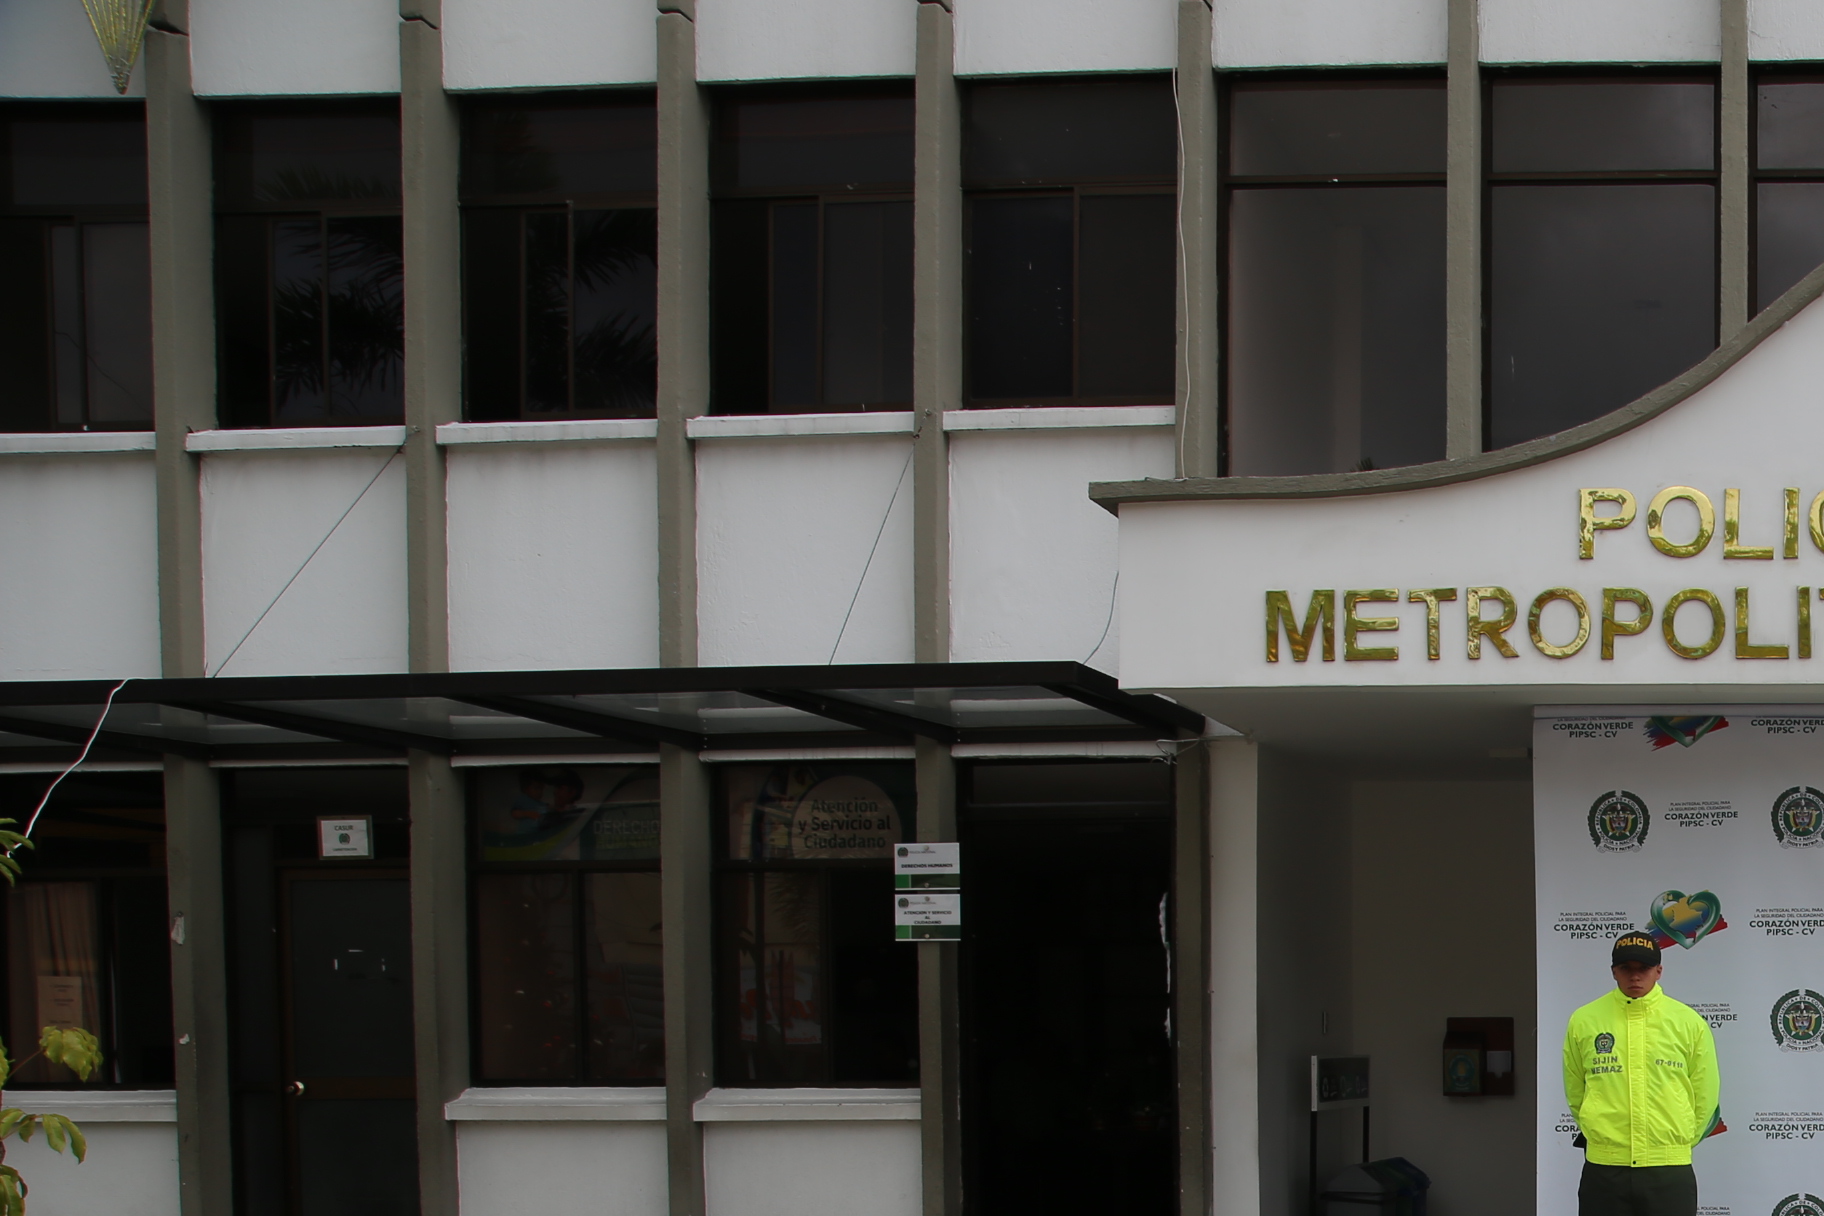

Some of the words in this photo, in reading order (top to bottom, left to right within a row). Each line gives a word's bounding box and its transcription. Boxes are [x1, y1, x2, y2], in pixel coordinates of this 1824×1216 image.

[811, 797, 878, 814] Atención
[1665, 811, 1710, 820] CORAZÓN
[1710, 812, 1738, 820] VERDE
[797, 819, 807, 834] y
[811, 814, 873, 832] Servicio
[877, 815, 892, 831] al
[1679, 819, 1704, 827] PIPSC
[1712, 819, 1724, 827] CV
[804, 832, 887, 849] Ciudadano
[1749, 918, 1800, 928] CORAZÓN
[1766, 928, 1794, 936] PIPSC
[1801, 928, 1816, 936] CV
[1616, 936, 1654, 950] POLICIA
[1592, 1056, 1618, 1065] SIJIN
[1748, 1122, 1799, 1132] CORAZÓN
[1765, 1131, 1793, 1140] PIPSC
[1801, 1131, 1815, 1140] CV
